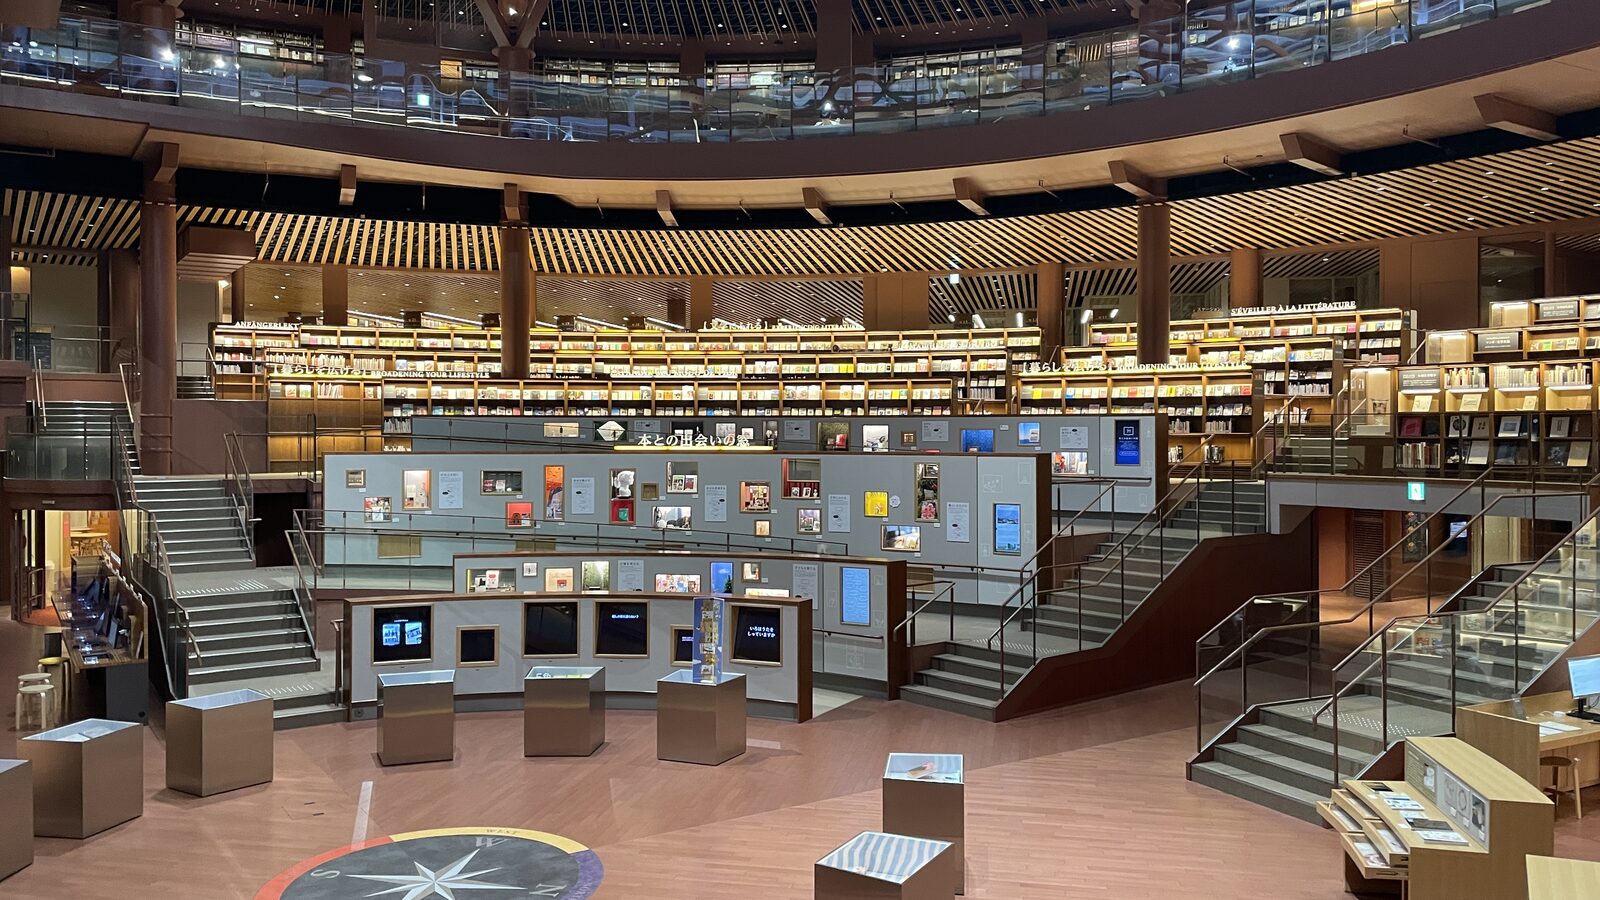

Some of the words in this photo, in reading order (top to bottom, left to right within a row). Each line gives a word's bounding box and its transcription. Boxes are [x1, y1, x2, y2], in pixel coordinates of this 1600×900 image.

[1174, 362, 1199, 370] YOUR
[371, 370, 424, 378] BROADENING
[449, 371, 490, 379] LIFESTYLE
